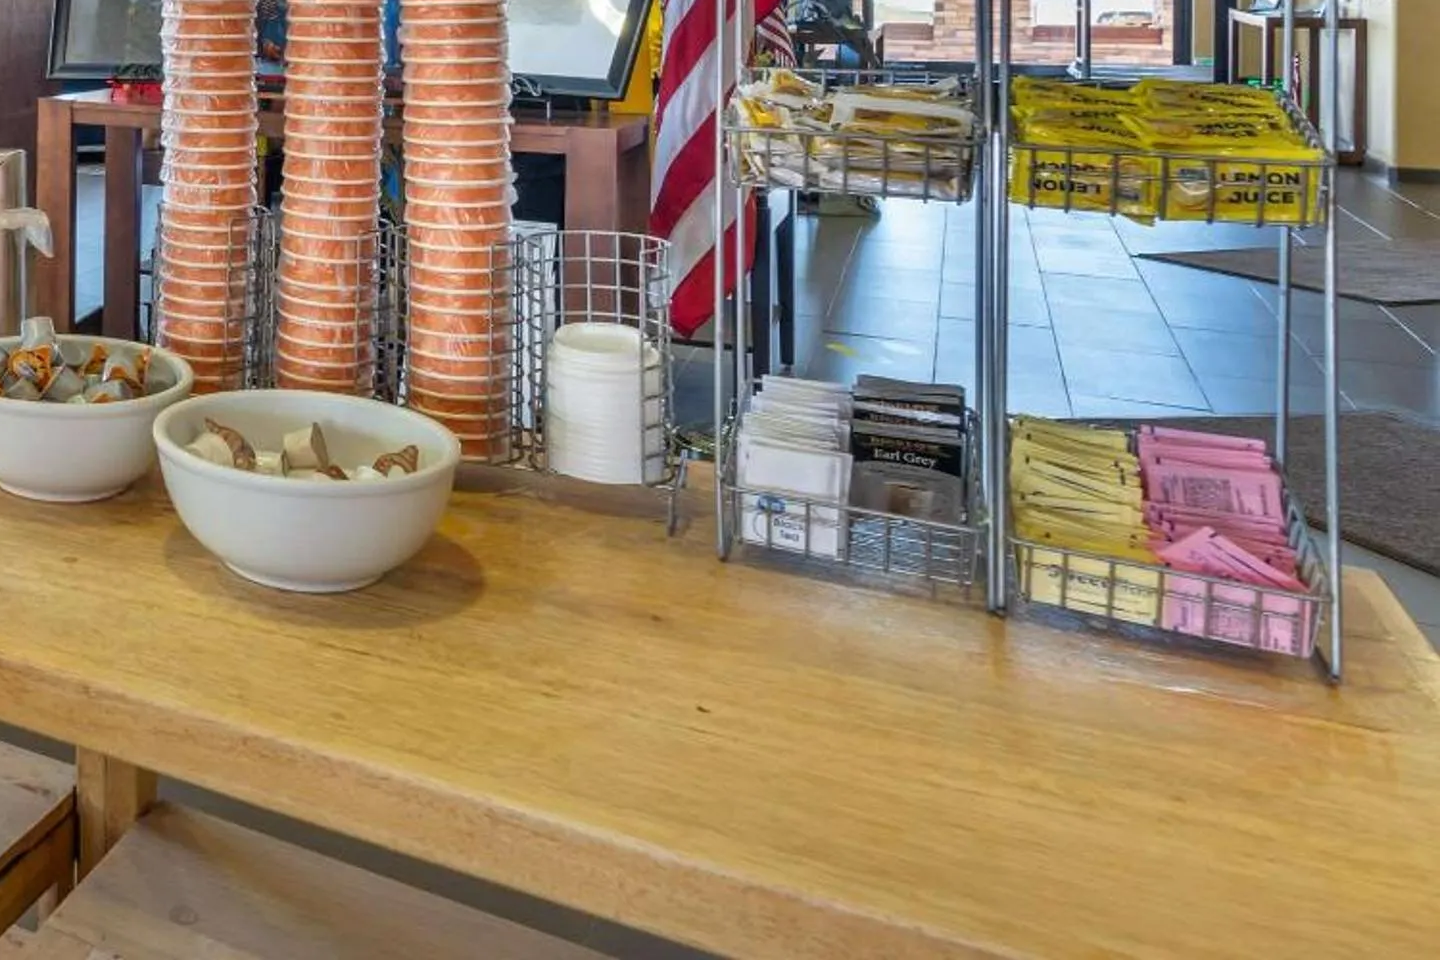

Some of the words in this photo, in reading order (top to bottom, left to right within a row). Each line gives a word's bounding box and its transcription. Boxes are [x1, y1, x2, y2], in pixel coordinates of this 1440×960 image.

[1229, 191, 1295, 205] JUCE
[874, 447, 900, 462] Earl
[903, 451, 937, 469] Grey
